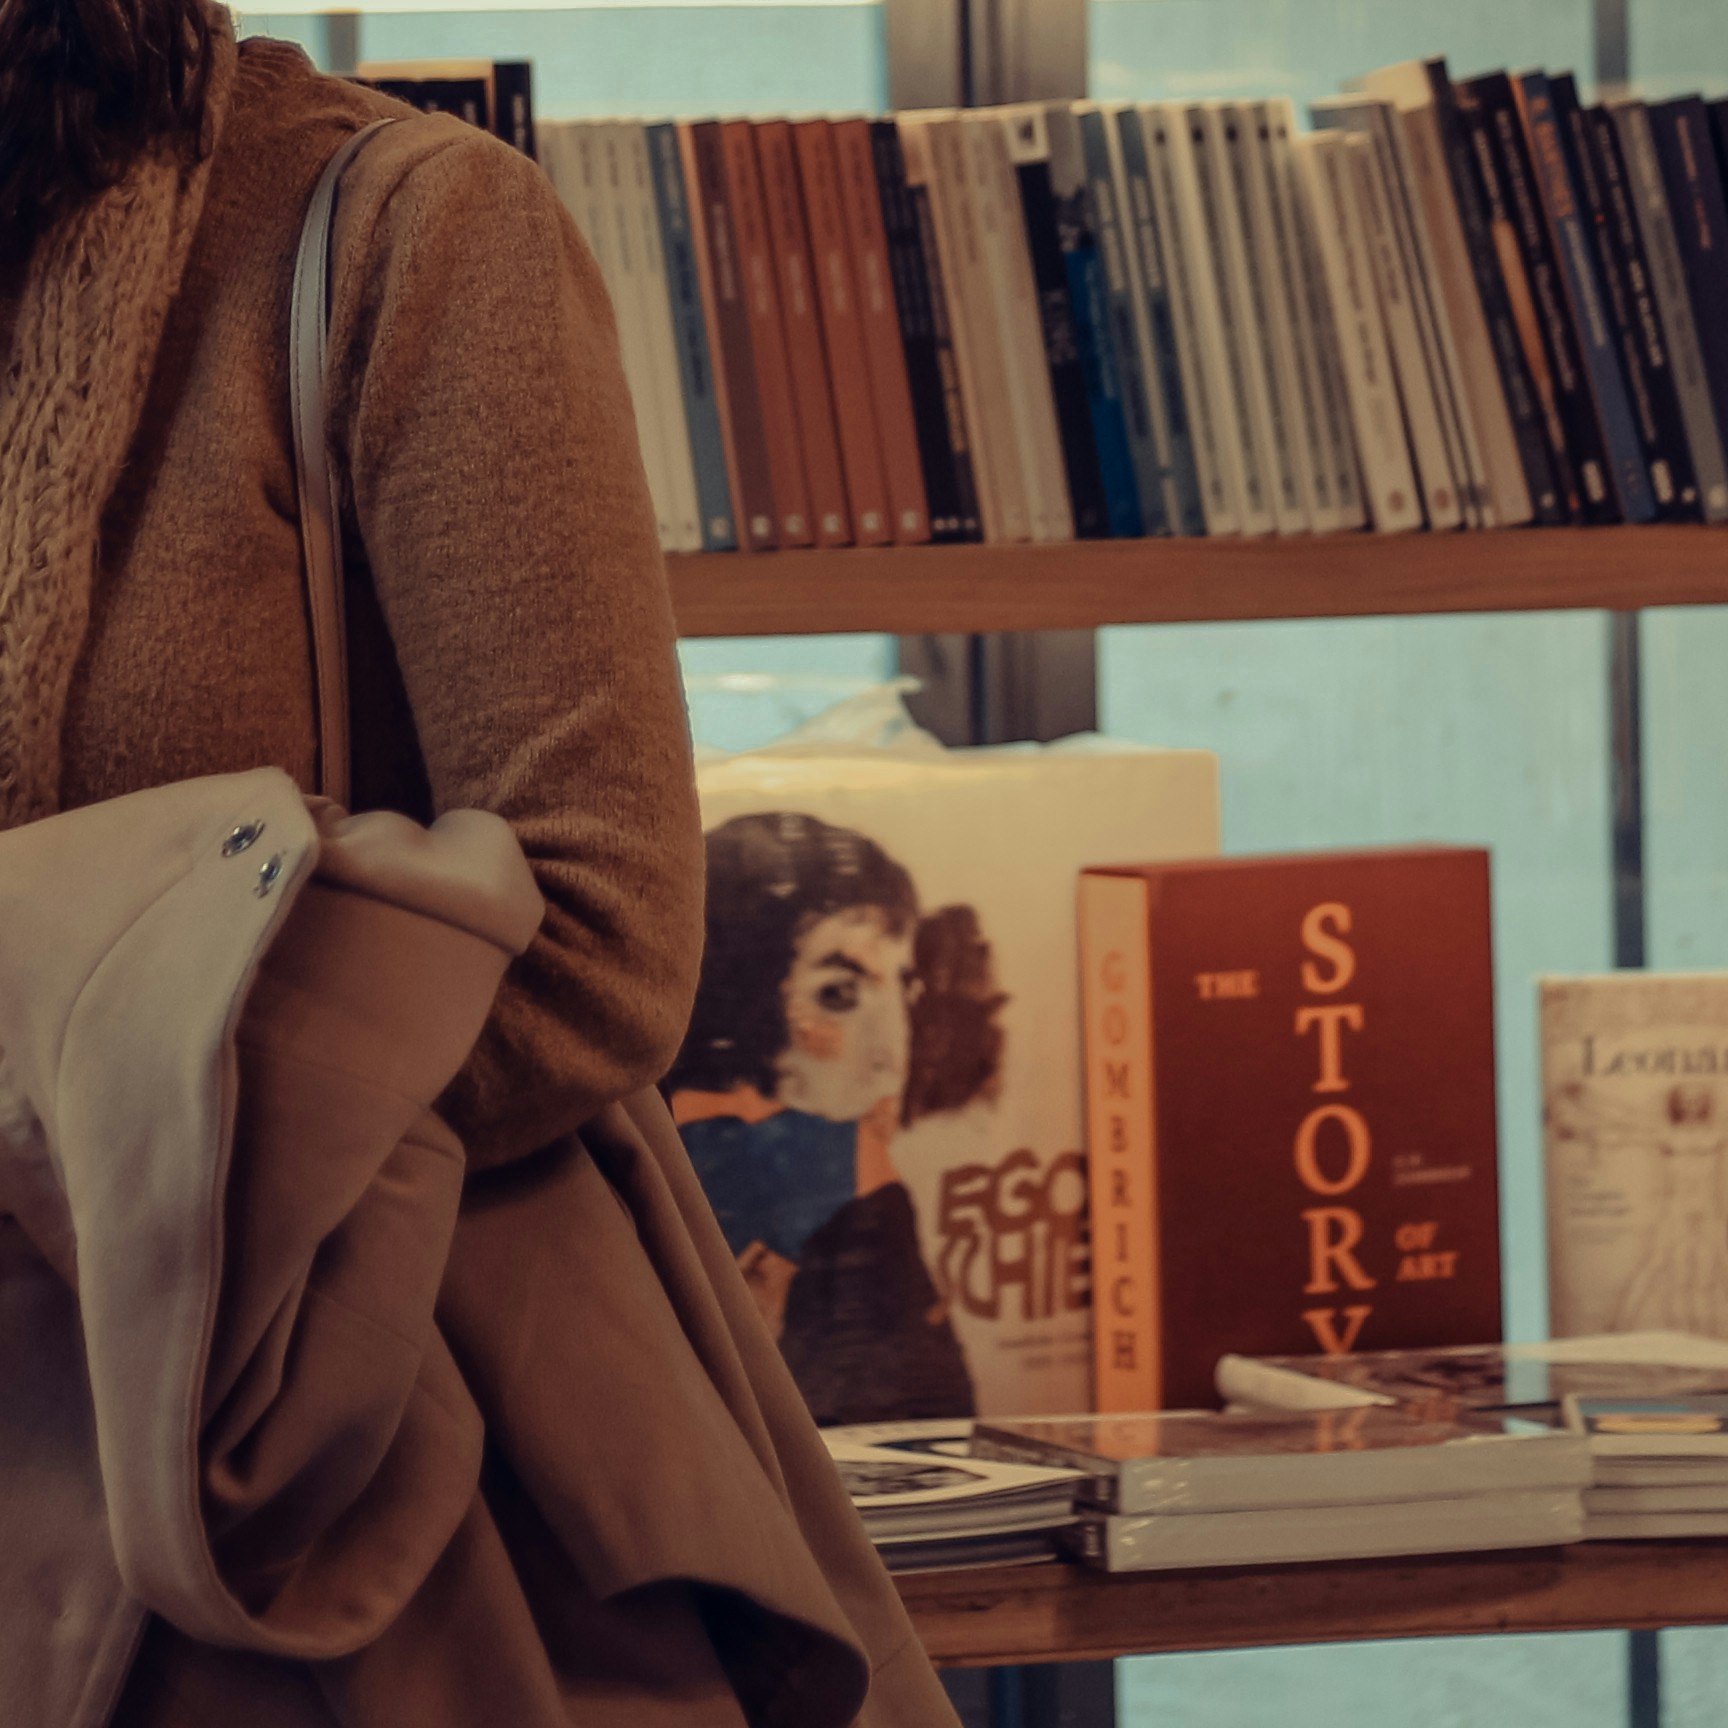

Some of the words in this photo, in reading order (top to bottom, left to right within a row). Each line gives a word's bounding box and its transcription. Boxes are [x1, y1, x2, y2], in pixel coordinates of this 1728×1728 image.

[1193, 967, 1262, 1002] THE
[1099, 948, 1138, 1372] GOMBRICH
[1292, 898, 1378, 1358] STORY
[1394, 1249, 1462, 1282] ART
